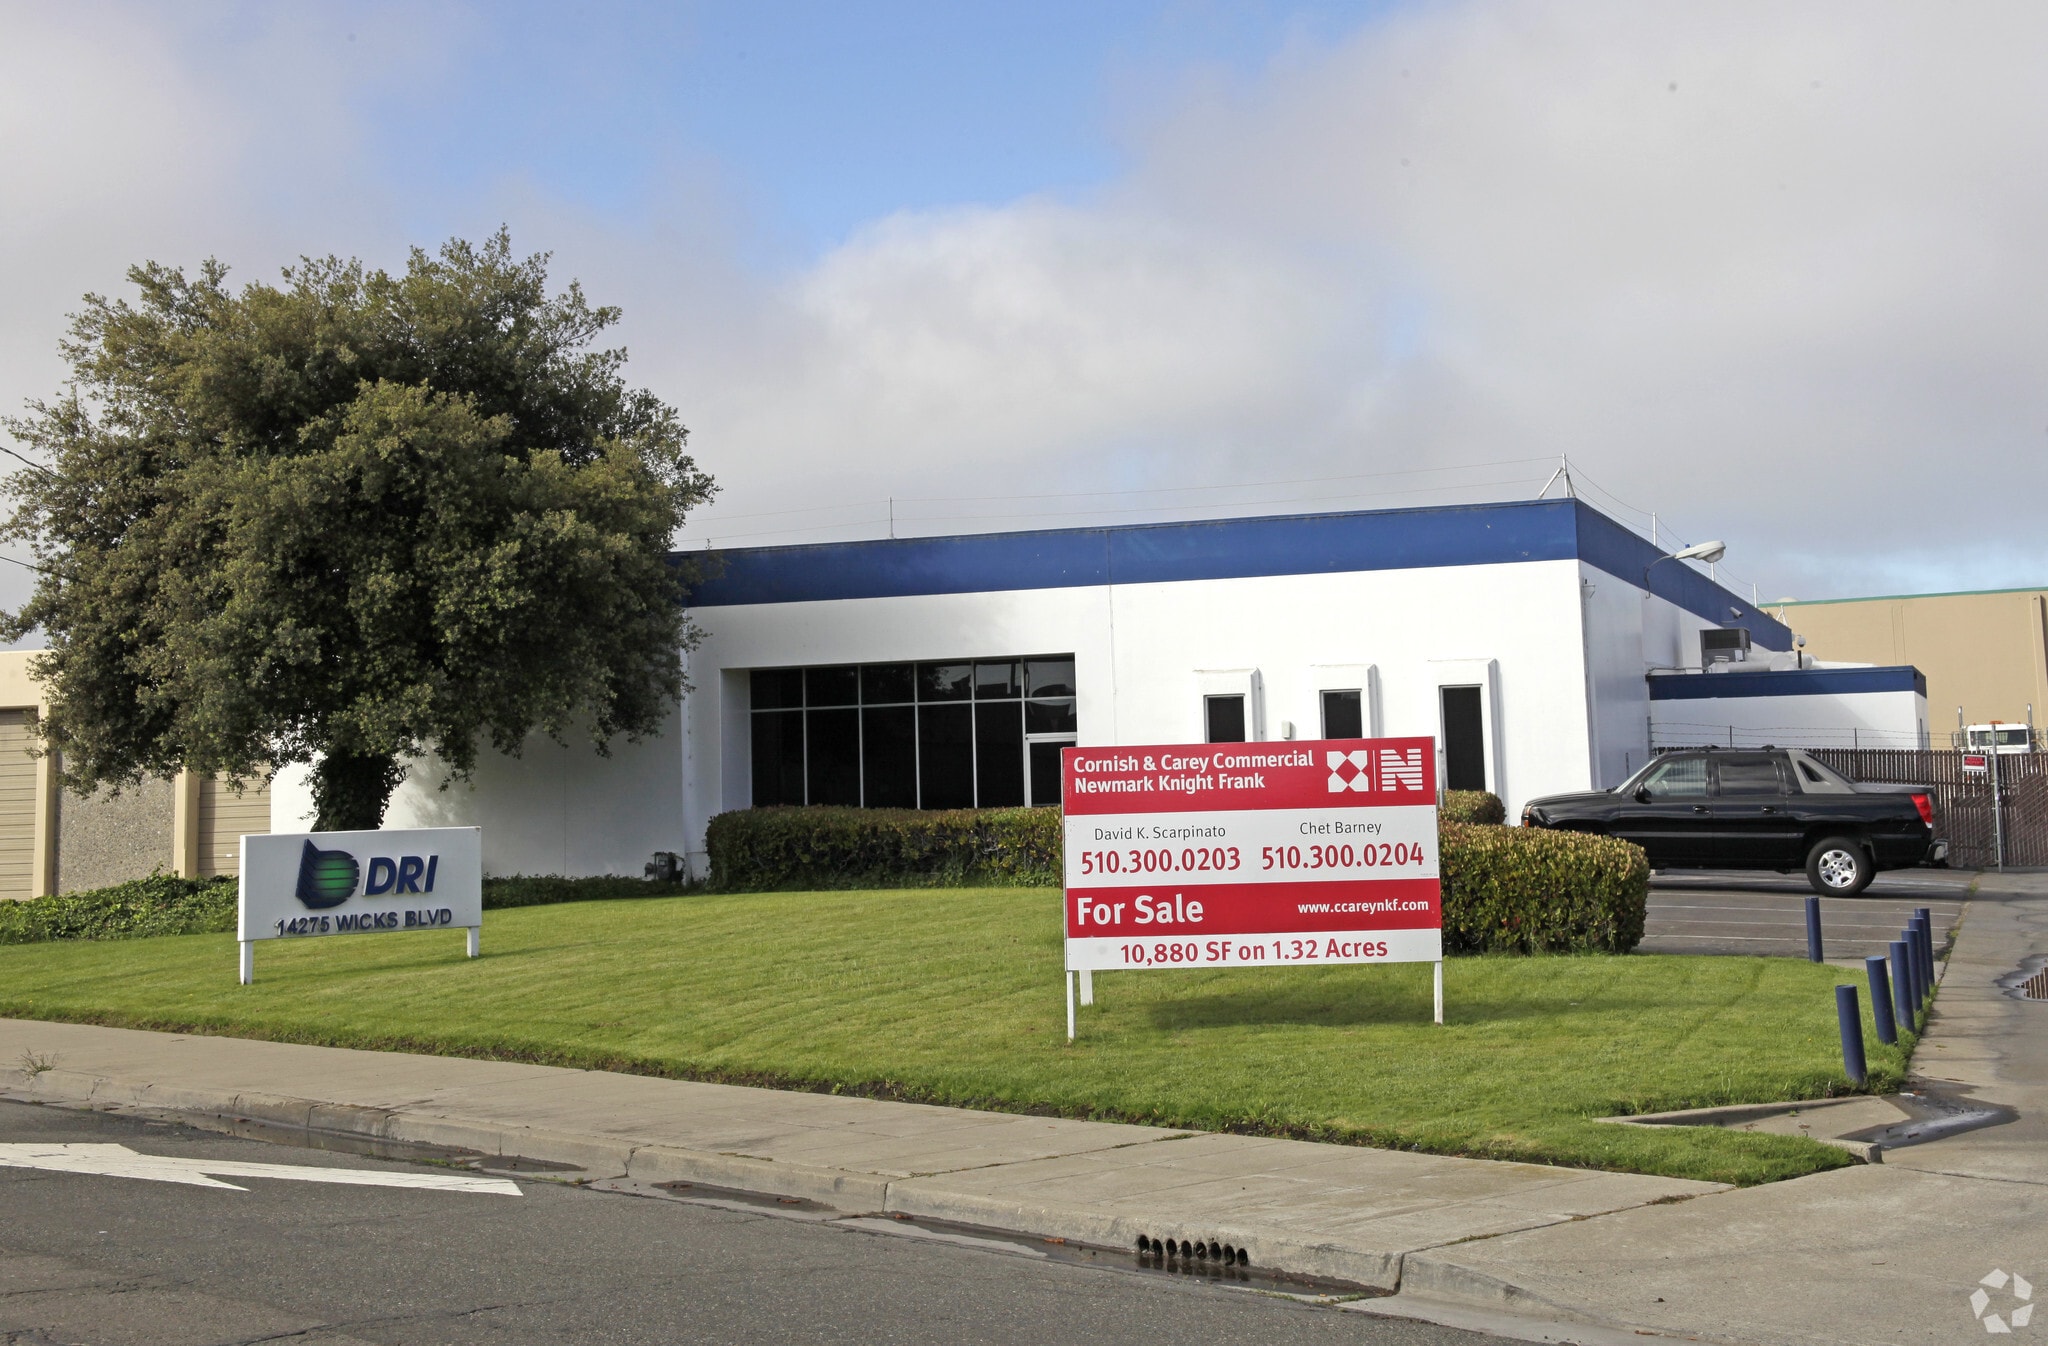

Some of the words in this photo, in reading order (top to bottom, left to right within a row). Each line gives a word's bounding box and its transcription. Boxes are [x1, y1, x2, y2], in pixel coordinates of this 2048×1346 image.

[1073, 755, 1139, 773] Cornish
[1143, 755, 1158, 771] &
[1160, 754, 1209, 773] Carey
[1212, 750, 1314, 769] Commercial
[1075, 775, 1155, 794] Newmark
[1158, 774, 1214, 795] Knight
[1218, 772, 1266, 790] Frank
[1094, 827, 1133, 841] David
[1137, 827, 1150, 840] K.
[1152, 825, 1226, 841] Scarpinato
[1299, 822, 1331, 835] Chet
[1334, 821, 1382, 835] Barney
[1081, 846, 1241, 875] 510.300.0203
[1262, 842, 1424, 870] 510.300.0204
[362, 854, 439, 896] DRI
[1077, 897, 1126, 926] For
[1134, 893, 1204, 924] Sale
[1297, 898, 1429, 915] www.ccareynkf.com
[274, 915, 330, 937] 14275
[335, 911, 399, 932] WICKS
[403, 908, 452, 928] BLVD
[1120, 942, 1199, 966] 10,880
[1205, 941, 1232, 961] SF
[1238, 944, 1265, 960] on
[1272, 939, 1319, 960] 1.32
[1325, 938, 1388, 958] Acres
